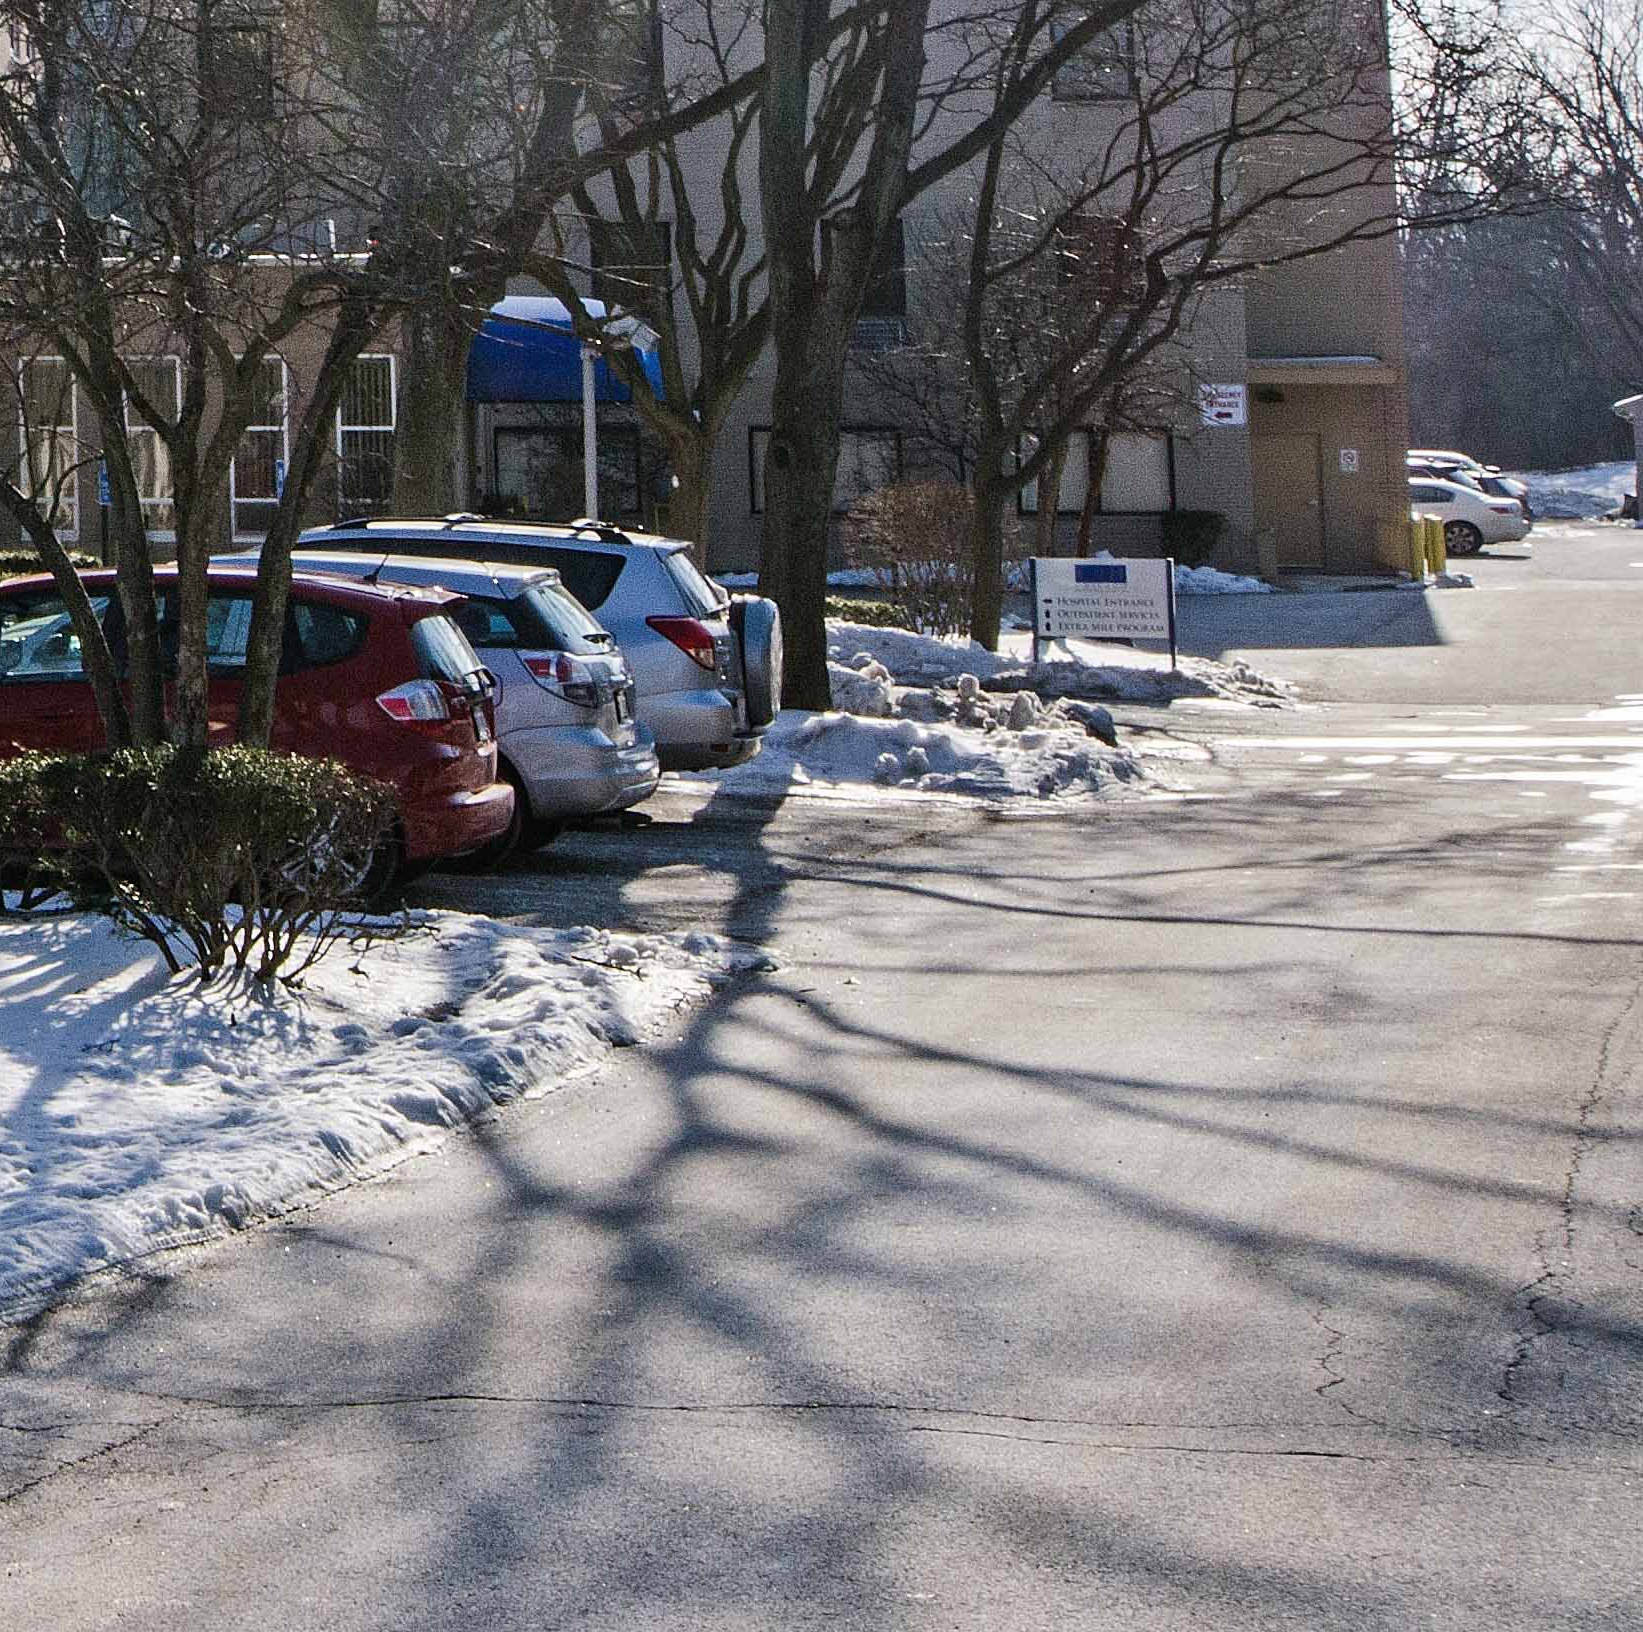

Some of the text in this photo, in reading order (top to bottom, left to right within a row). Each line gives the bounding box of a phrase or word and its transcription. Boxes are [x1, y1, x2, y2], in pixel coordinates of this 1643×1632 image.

[1057, 597, 1154, 607] HOSPITAL ENTRANCE
[1057, 609, 1160, 619] OUTPATIENT SERVICES
[1117, 622, 1164, 632] PROGRAM
